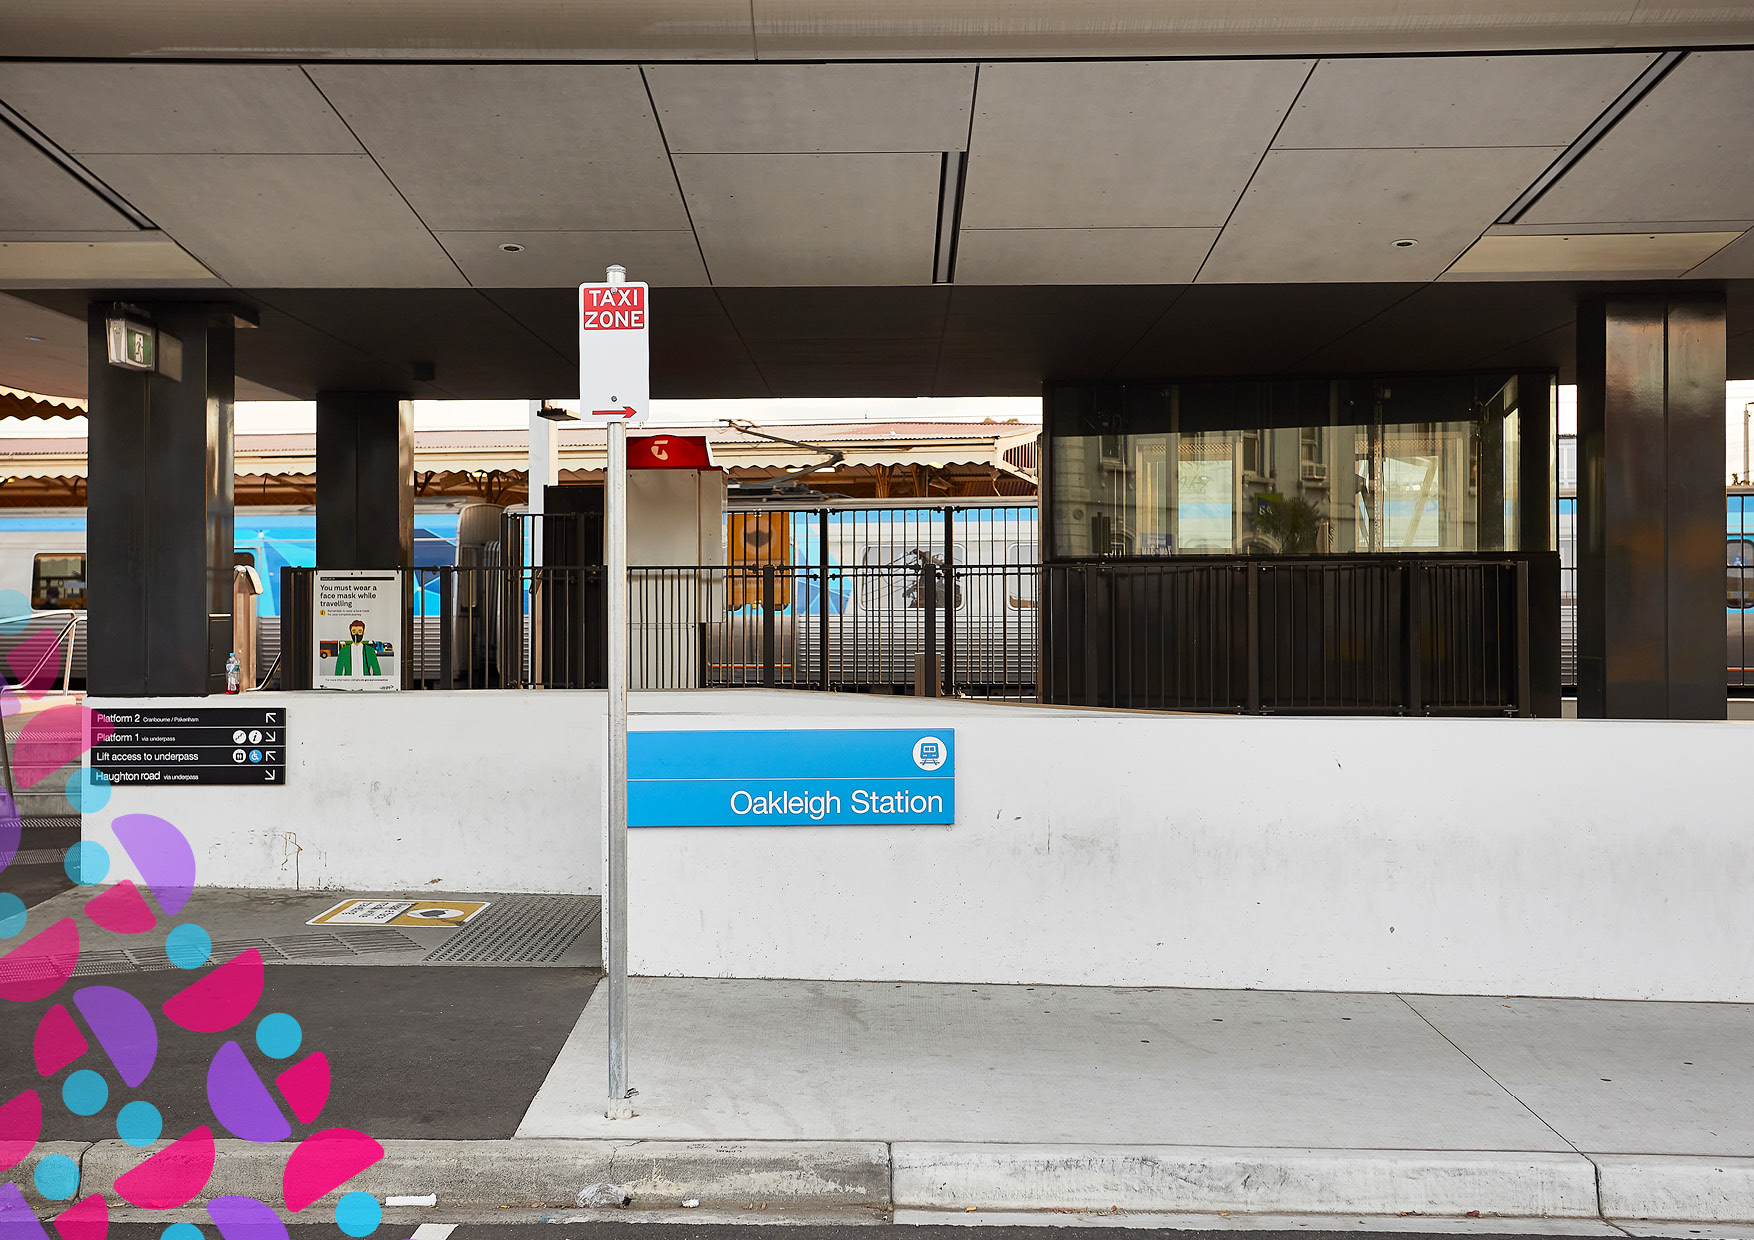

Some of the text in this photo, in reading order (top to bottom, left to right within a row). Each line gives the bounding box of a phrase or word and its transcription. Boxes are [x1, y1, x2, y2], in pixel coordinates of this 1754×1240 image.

[589, 289, 638, 307] TAXI
[584, 310, 644, 328] ZONE
[97, 714, 132, 723] Platform
[134, 714, 140, 723] 2
[96, 733, 132, 742] Platform
[135, 733, 139, 742] 1
[96, 752, 111, 761] Lift
[144, 753, 153, 761] to
[154, 752, 199, 763] underpass
[95, 771, 139, 782] Haughton
[141, 771, 161, 781] road
[730, 789, 943, 820] Oakleigh Station
